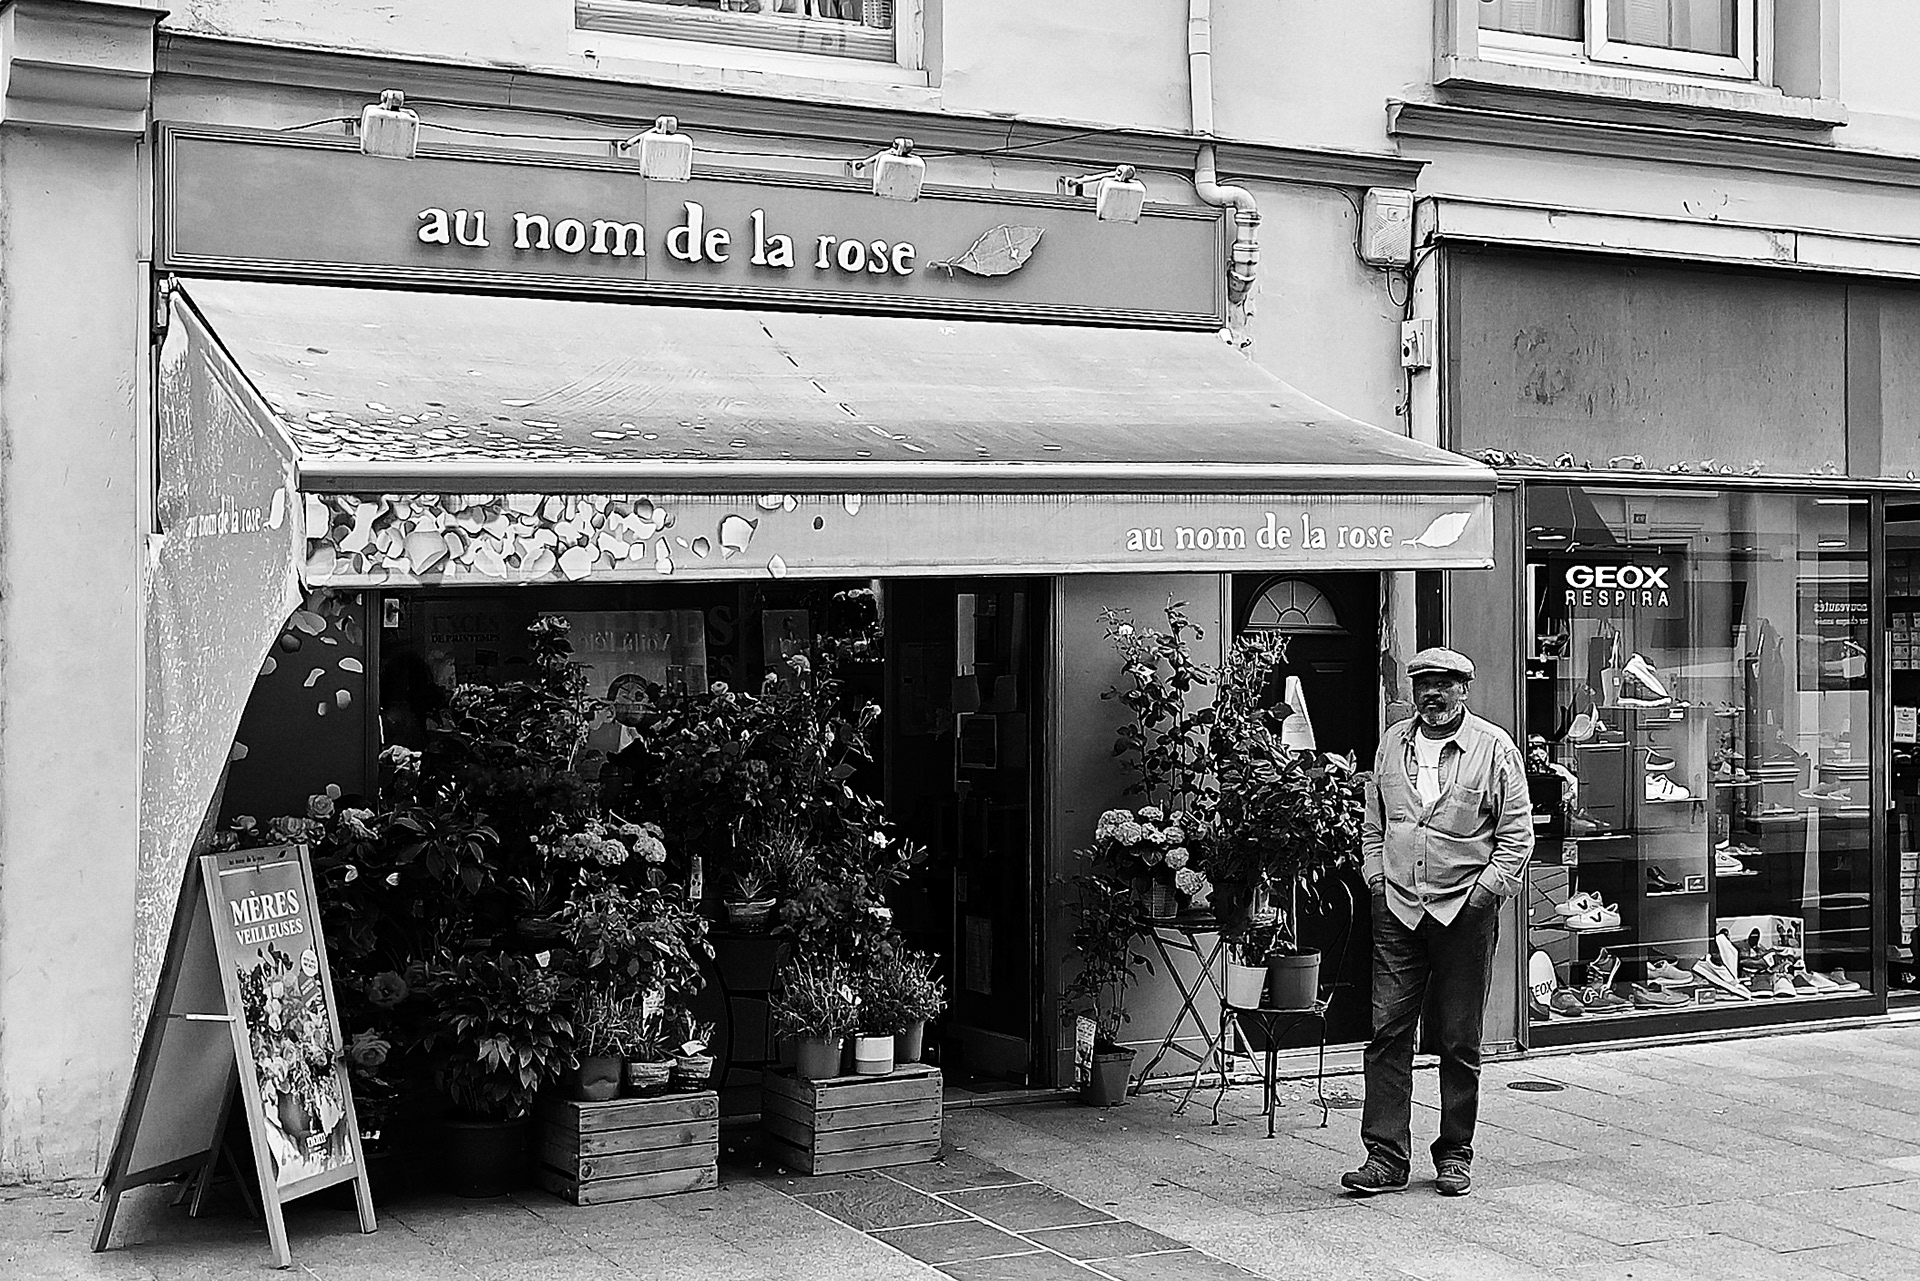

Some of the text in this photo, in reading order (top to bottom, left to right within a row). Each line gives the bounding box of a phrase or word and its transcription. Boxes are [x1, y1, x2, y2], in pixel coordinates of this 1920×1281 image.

[418, 201, 915, 275] au nom de la rose
[242, 507, 261, 532] rose
[1126, 512, 1393, 551] au nom de la rose
[1565, 566, 1669, 588] GEOX
[1566, 590, 1669, 606] RESPIRA
[230, 889, 300, 926] MÈRES
[235, 918, 304, 945] VEILLEUSES
[1529, 980, 1553, 997] EOX
